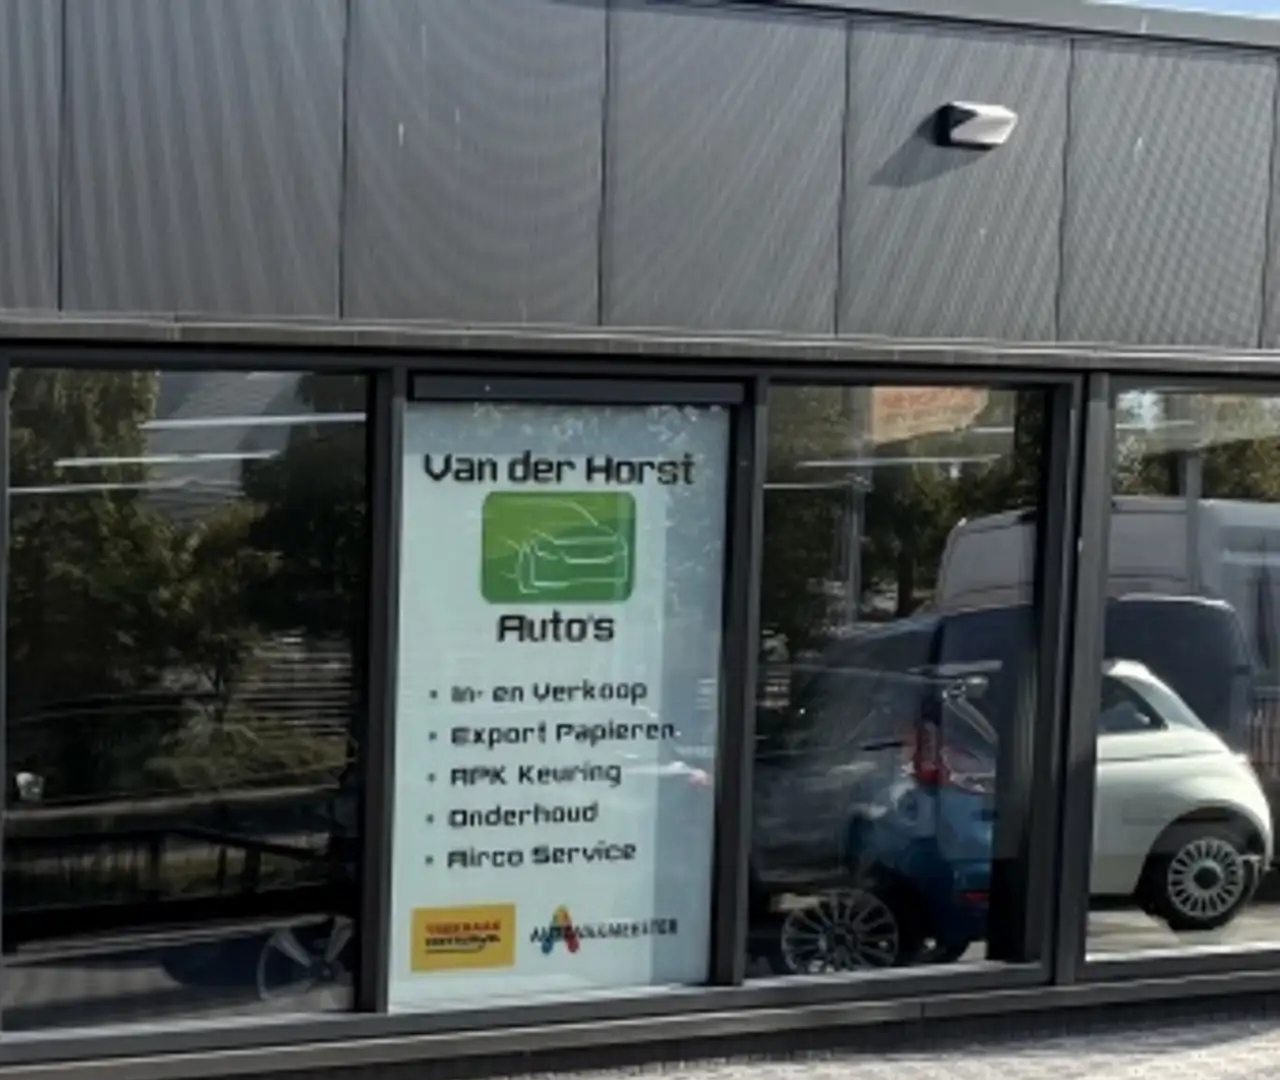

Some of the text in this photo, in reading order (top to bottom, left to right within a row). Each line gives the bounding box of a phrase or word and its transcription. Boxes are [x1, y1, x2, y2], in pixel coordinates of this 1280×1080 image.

[423, 450, 696, 486] Van der Horst
[496, 608, 616, 643] Auto's
[491, 686, 525, 703] en
[533, 679, 649, 706] Verkoop
[450, 719, 677, 751] Export Papieren
[450, 758, 623, 788] APK Keuring
[447, 800, 600, 829] Onderhoud
[447, 839, 638, 869] Airco Service
